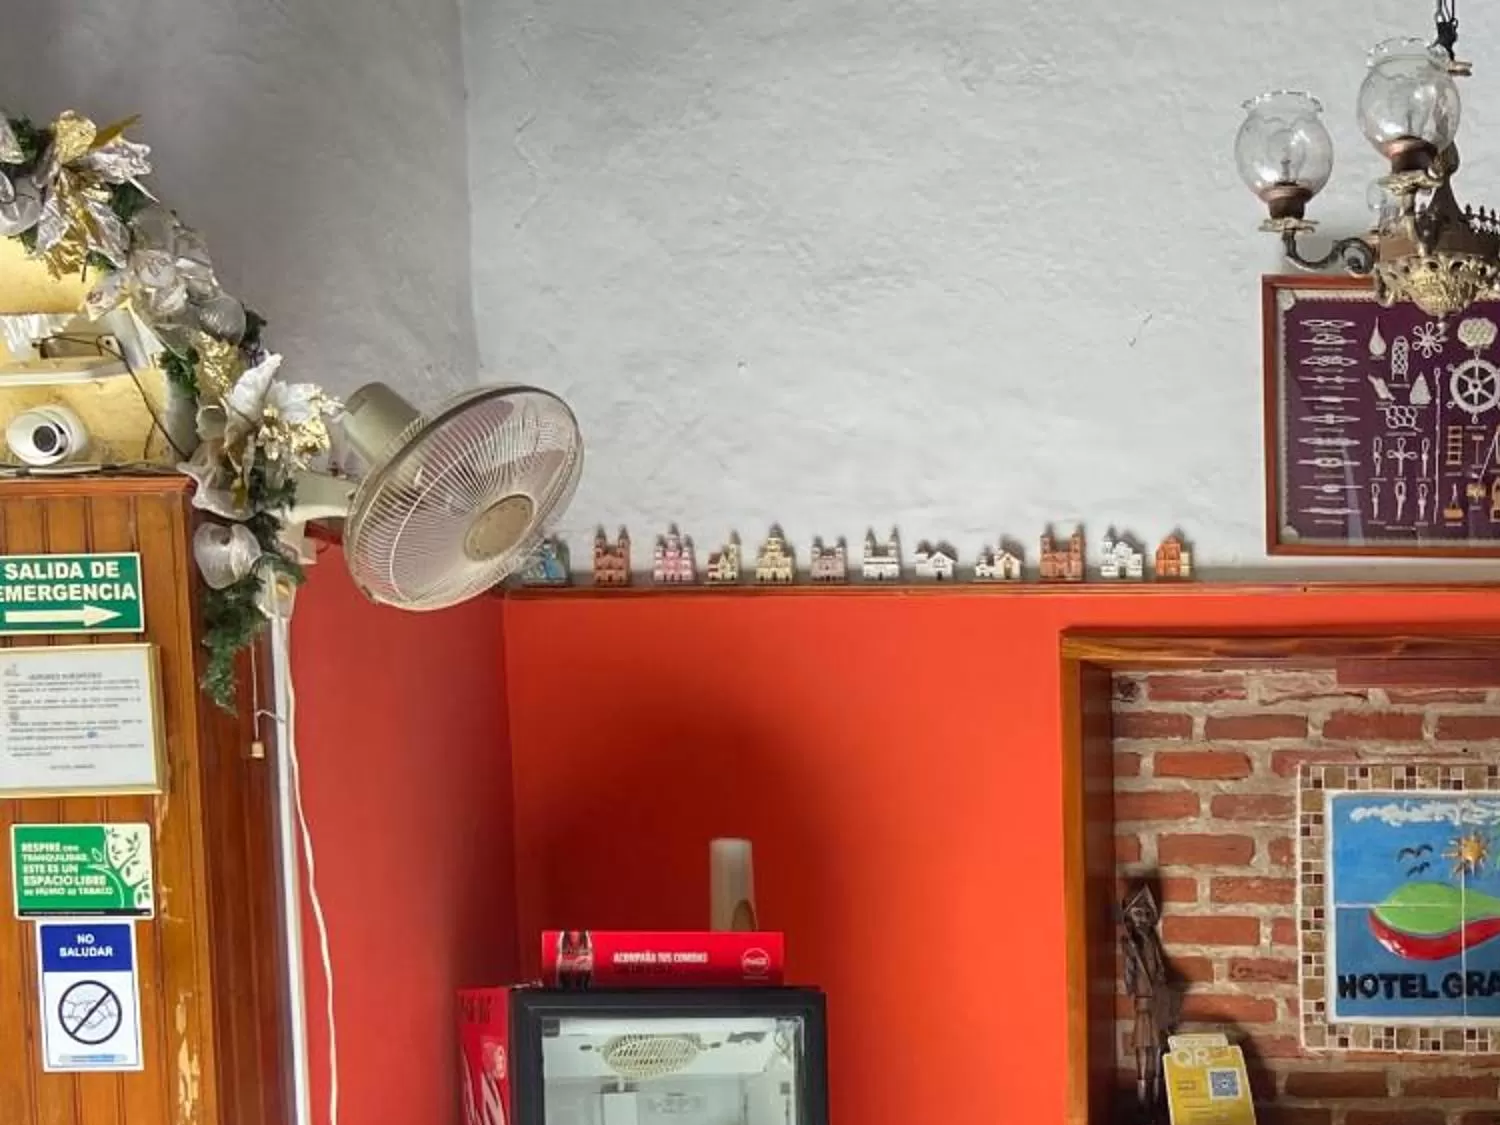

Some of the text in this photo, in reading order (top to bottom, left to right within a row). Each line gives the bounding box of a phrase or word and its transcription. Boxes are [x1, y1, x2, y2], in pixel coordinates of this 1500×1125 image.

[4, 561, 120, 580] SALIDA DE
[23, 863, 79, 873] ESTE ES UN
[23, 875, 107, 886] ESPACIO LIBRE
[35, 887, 65, 896] HUMO
[78, 887, 114, 895] TABACO
[77, 933, 95, 945] NO
[59, 946, 113, 957] SALUDAR
[1338, 972, 1441, 1000] HOTEL
